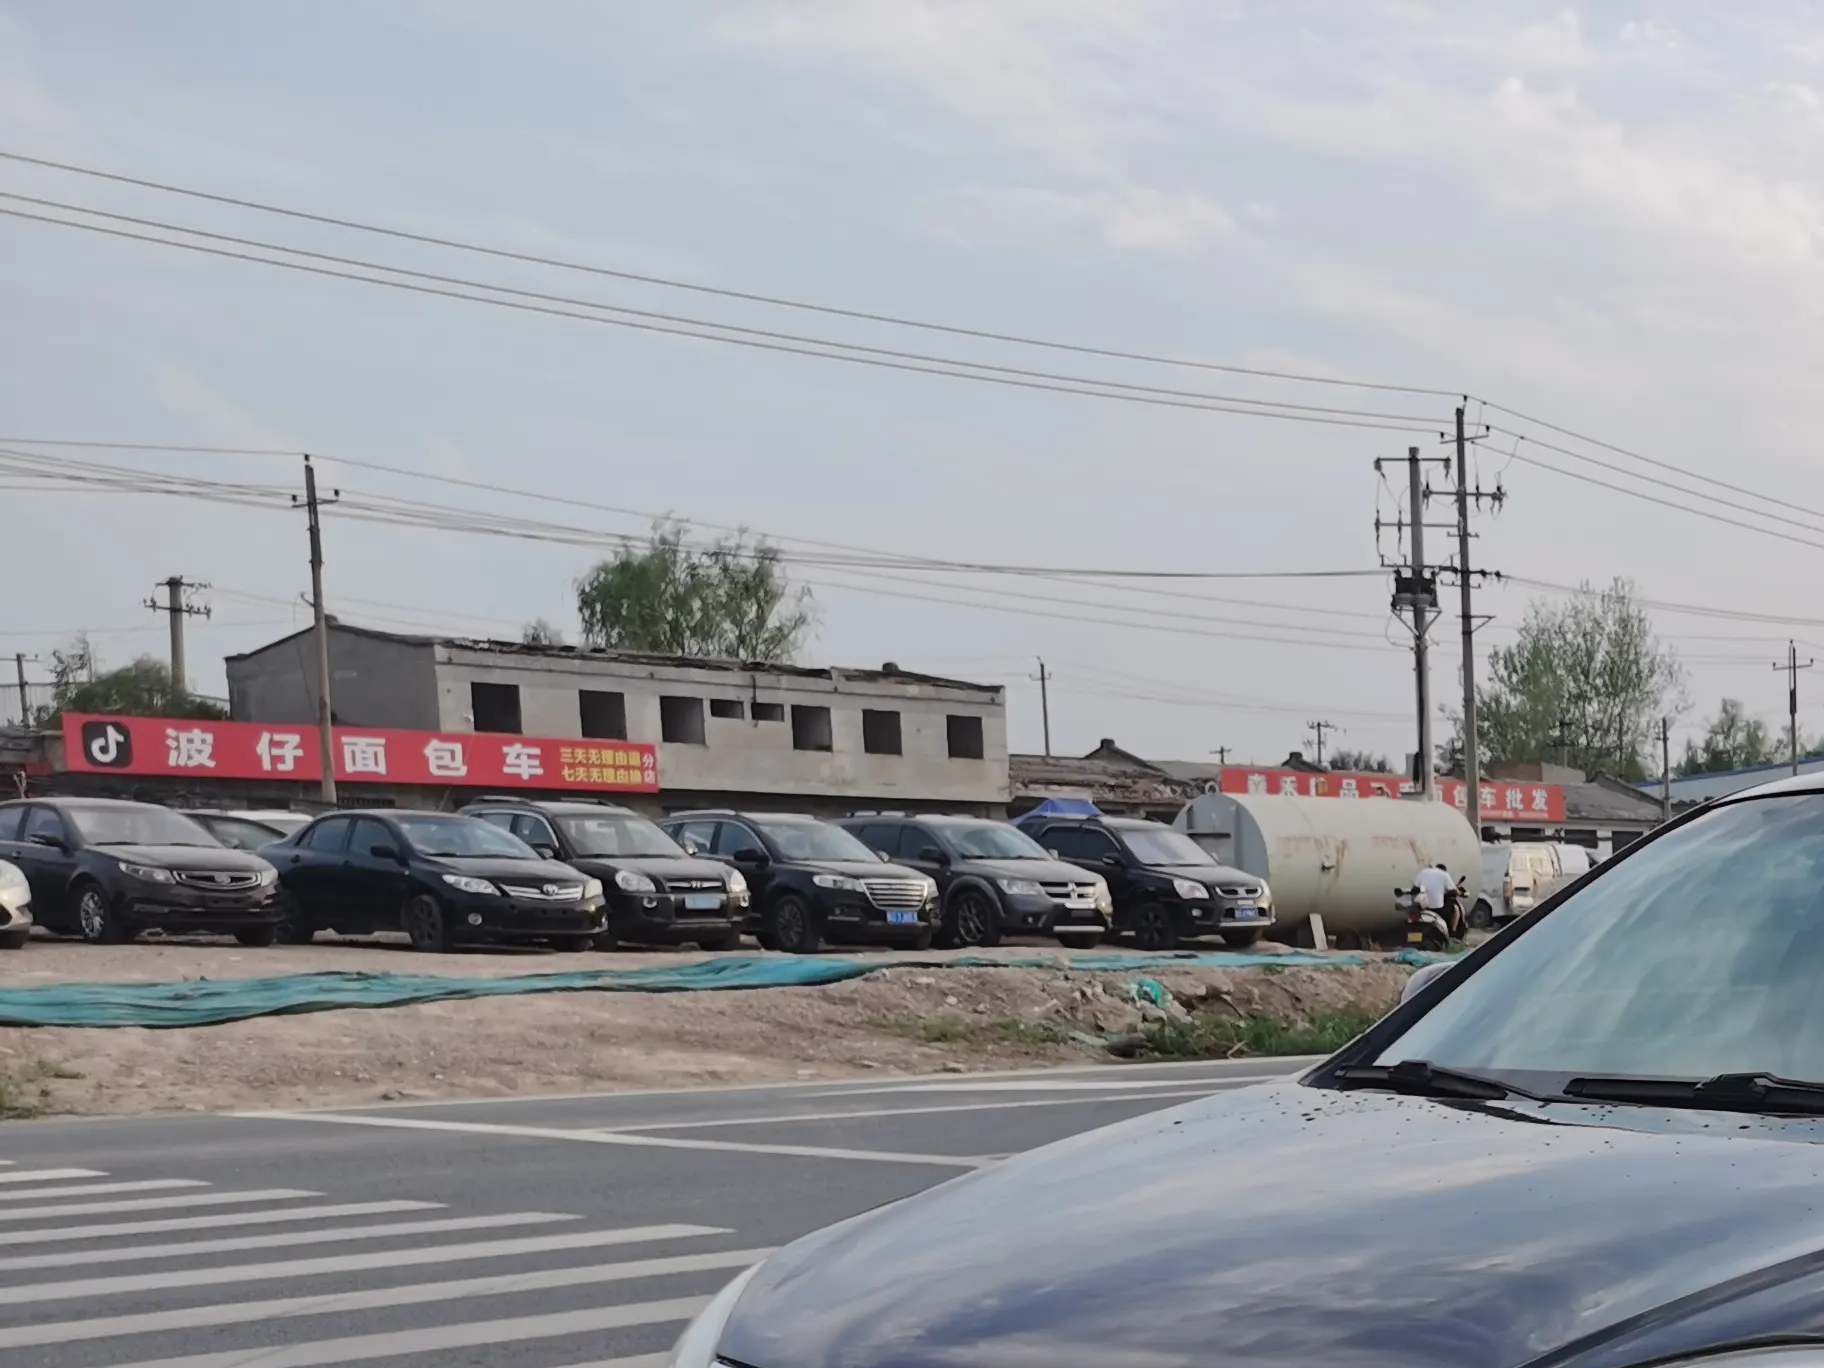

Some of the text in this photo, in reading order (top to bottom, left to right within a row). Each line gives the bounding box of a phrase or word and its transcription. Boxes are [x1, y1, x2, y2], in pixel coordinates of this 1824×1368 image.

[165, 728, 544, 780] 波仔面包车
